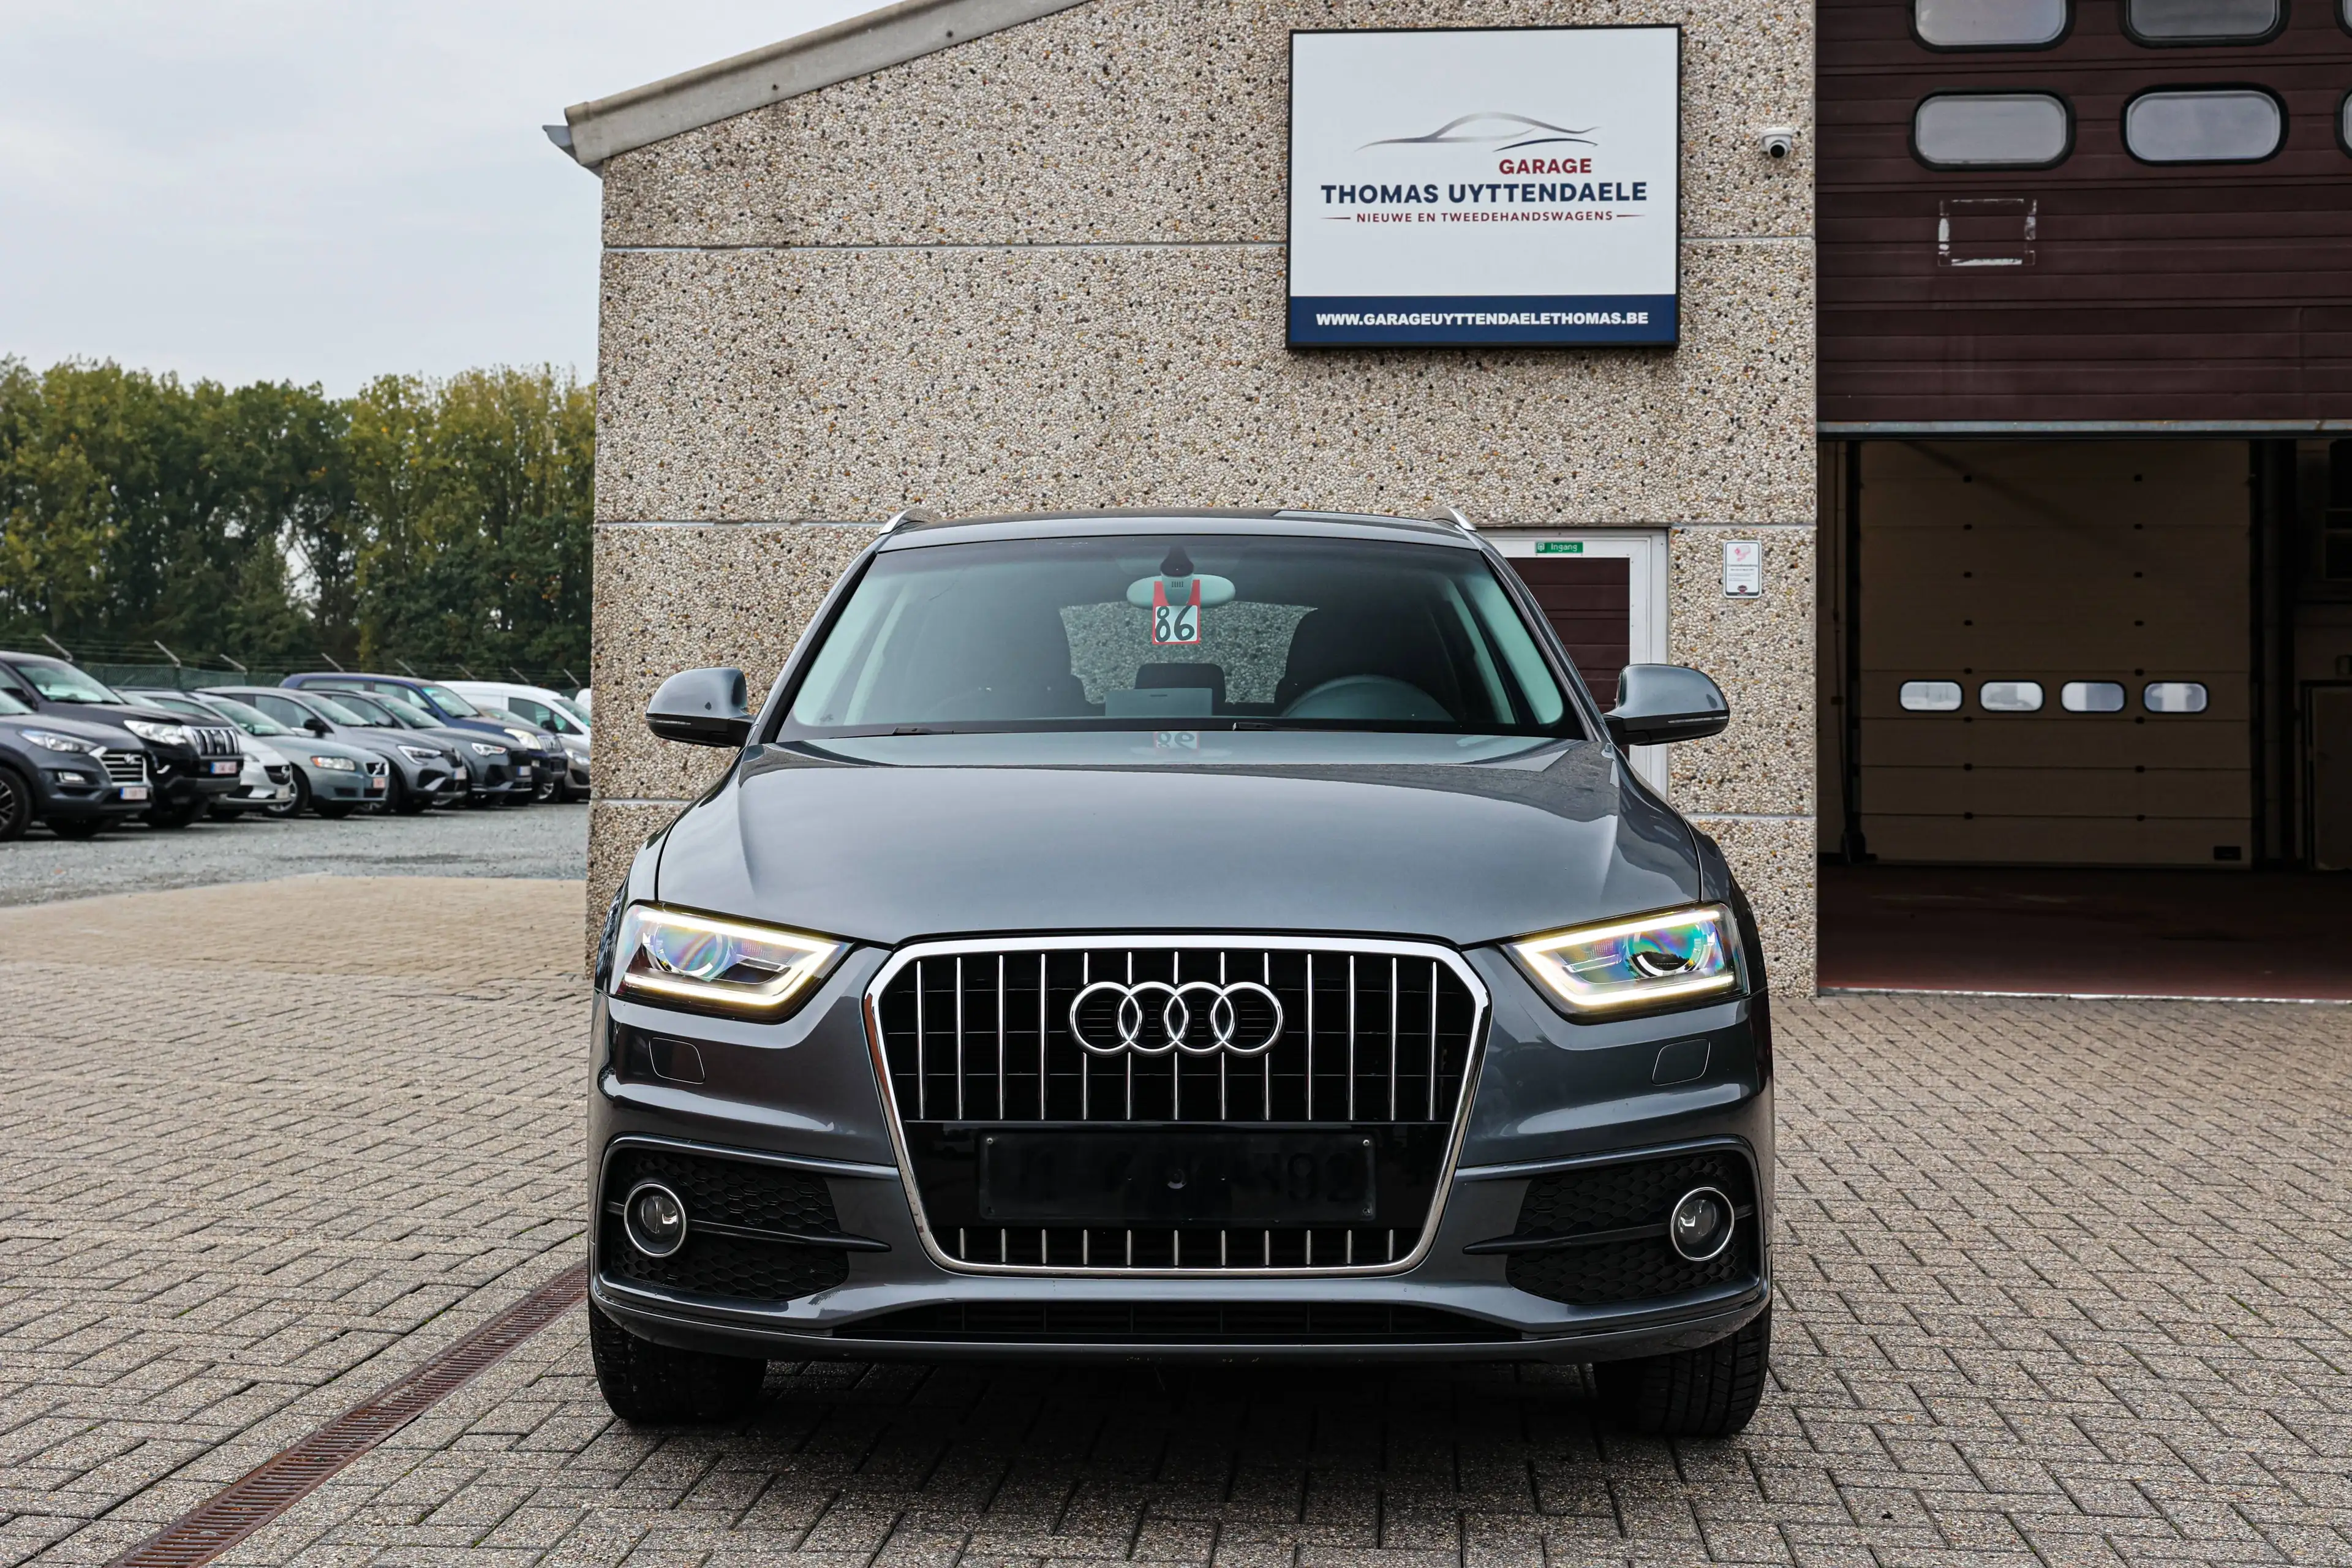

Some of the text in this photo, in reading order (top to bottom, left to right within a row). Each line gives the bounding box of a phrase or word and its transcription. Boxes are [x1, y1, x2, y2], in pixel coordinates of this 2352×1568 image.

[1499, 158, 1592, 175] GARAGE
[1321, 181, 1647, 203] THOMAS UYTTENDAELE
[1356, 211, 1613, 222] NIEUWE EN TWEEDEHANDSWAGENS
[1316, 312, 1649, 326] WWW.GARAGEUYTTENDAELETHOMAS.BE
[1550, 542, 1578, 552] Ingang
[1155, 605, 1195, 643] 86
